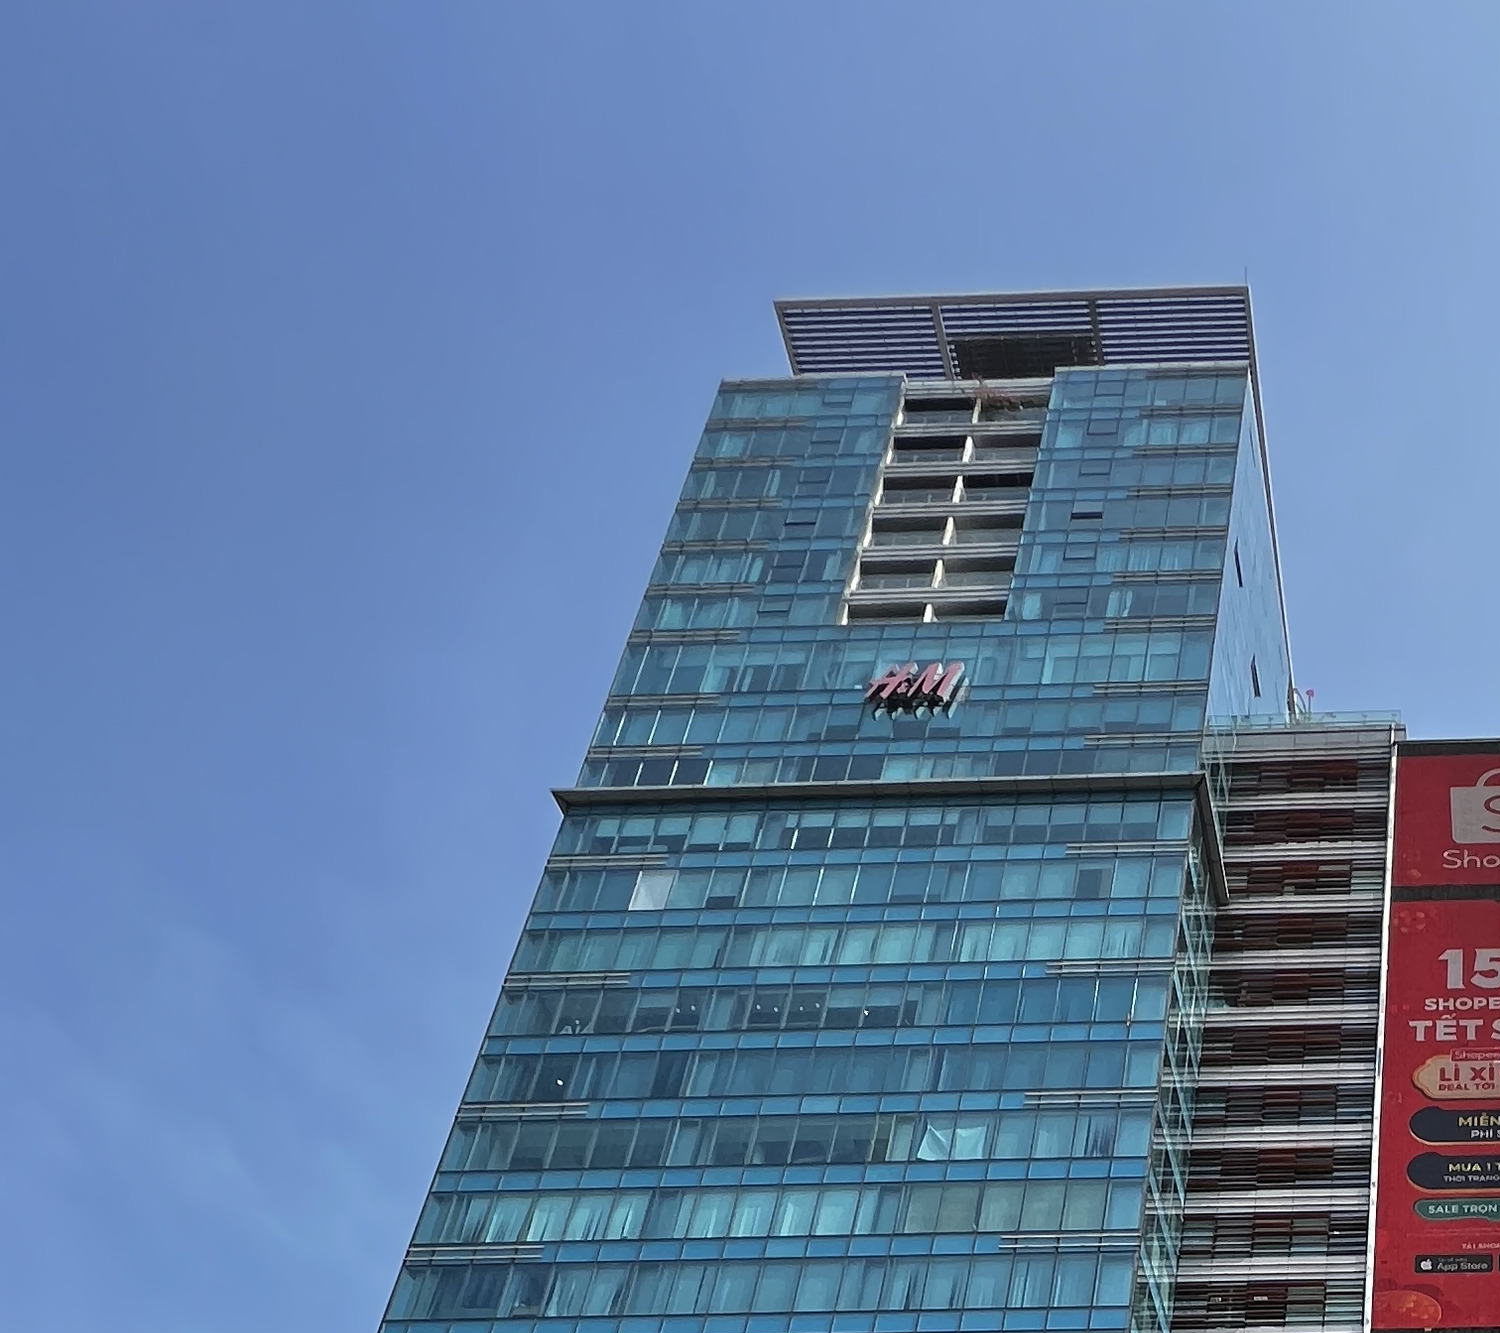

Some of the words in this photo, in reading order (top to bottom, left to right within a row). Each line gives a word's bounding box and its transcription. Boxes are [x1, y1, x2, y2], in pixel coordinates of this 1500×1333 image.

[864, 661, 966, 702] H&M
[1408, 1013, 1484, 1042] TẾT
[1453, 1049, 1500, 1062] Shopee
[1438, 1083, 1470, 1092] DEAL
[1448, 1162, 1482, 1173] MUA
[1428, 1204, 1459, 1214] SALE
[1437, 1262, 1459, 1272] App
[1460, 1262, 1488, 1271] Store
